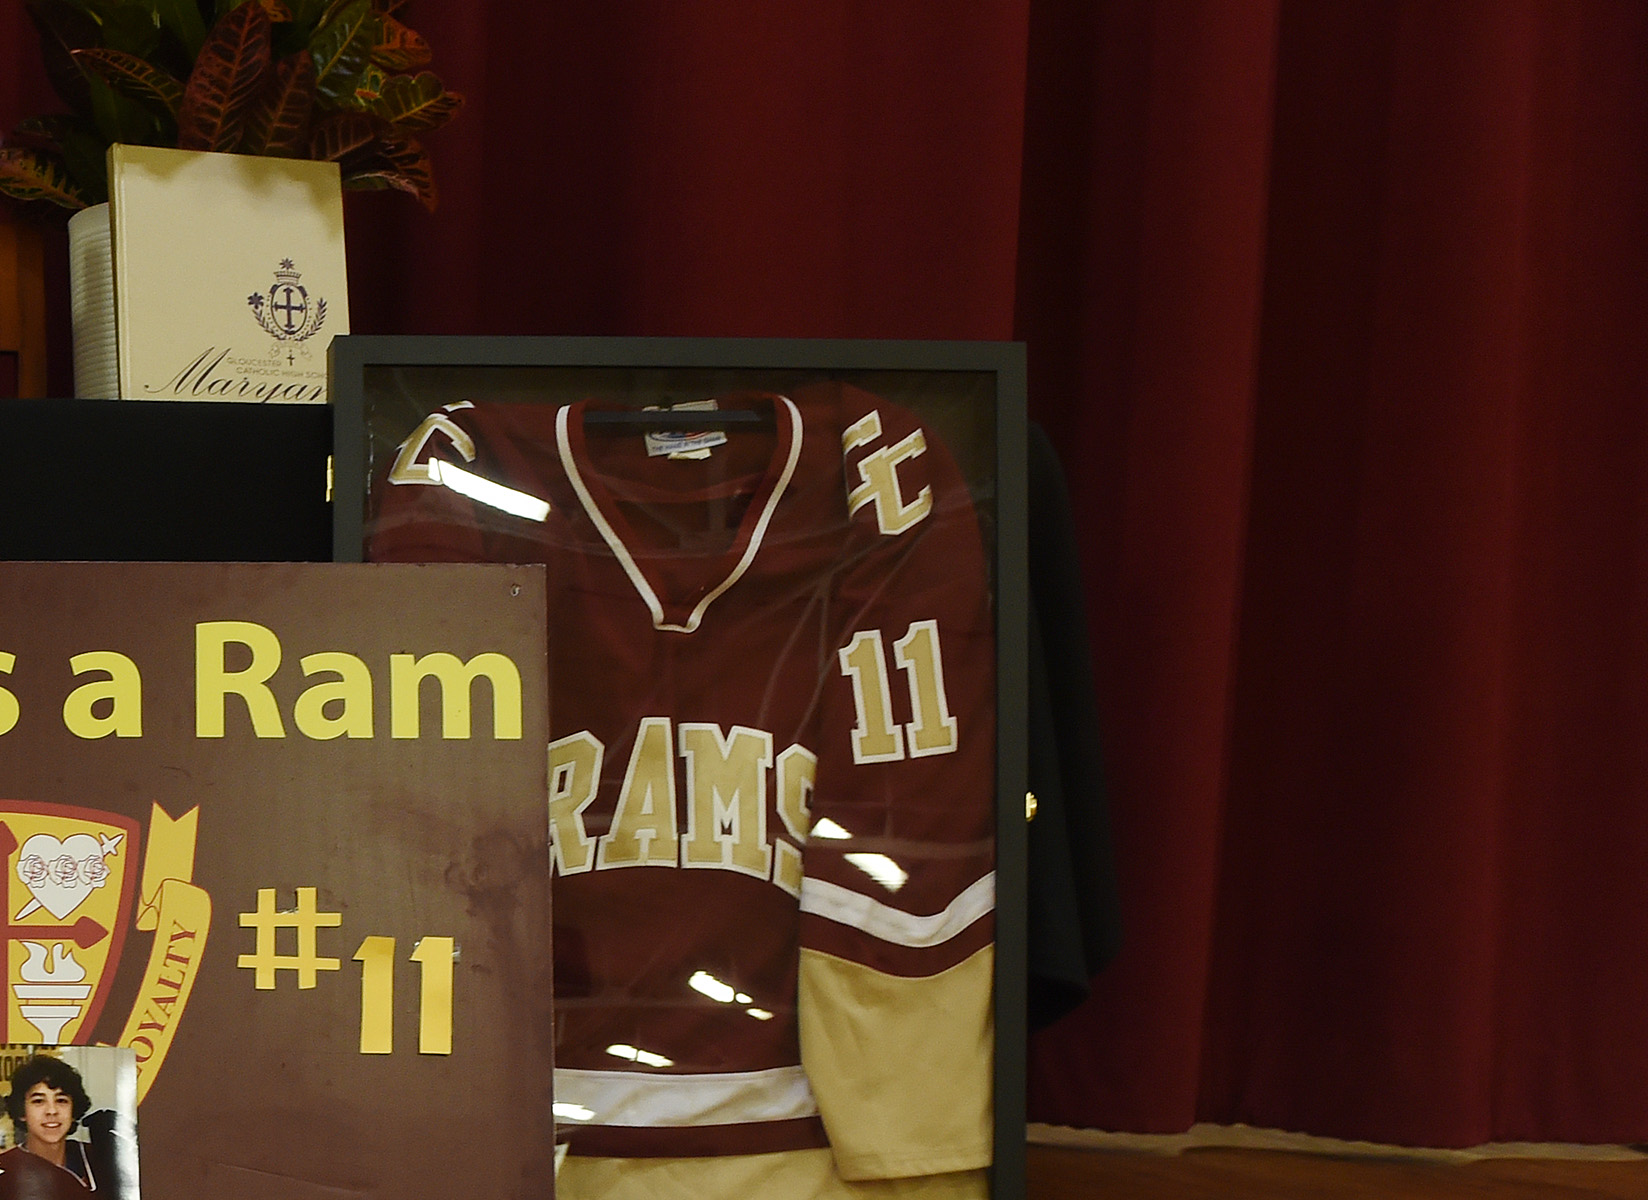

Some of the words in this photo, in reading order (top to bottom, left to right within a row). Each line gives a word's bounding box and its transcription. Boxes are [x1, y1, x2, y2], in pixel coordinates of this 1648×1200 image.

[236, 366, 280, 378] CATHOLIC
[63, 651, 142, 739] a
[196, 621, 523, 740] Ram
[839, 619, 958, 765] 11
[549, 716, 818, 898] RAMS
[128, 919, 197, 1079] OYALTY
[238, 886, 456, 1056] #11
